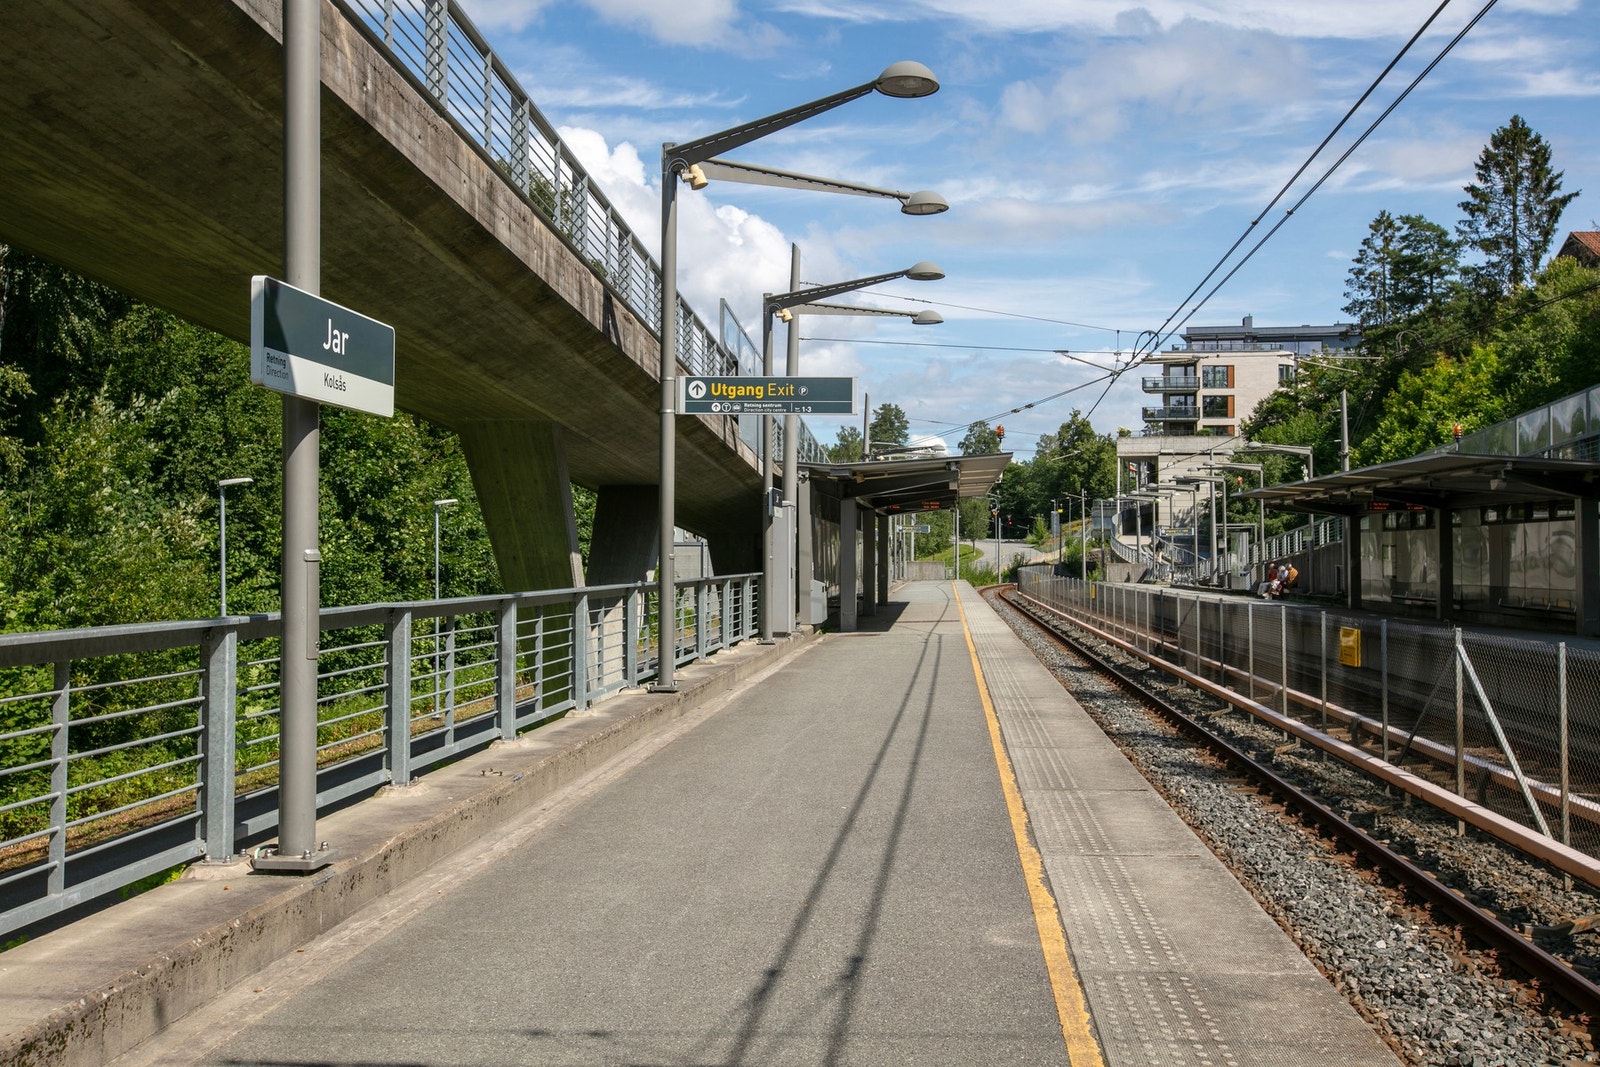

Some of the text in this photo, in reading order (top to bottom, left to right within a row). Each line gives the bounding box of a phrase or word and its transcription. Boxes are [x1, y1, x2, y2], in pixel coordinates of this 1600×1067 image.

[323, 318, 350, 356] Jar
[266, 352, 287, 369] Retning
[266, 365, 289, 380] Direction
[323, 372, 347, 392] Kolsås
[711, 382, 764, 399] Utgang
[767, 382, 795, 396] Exit
